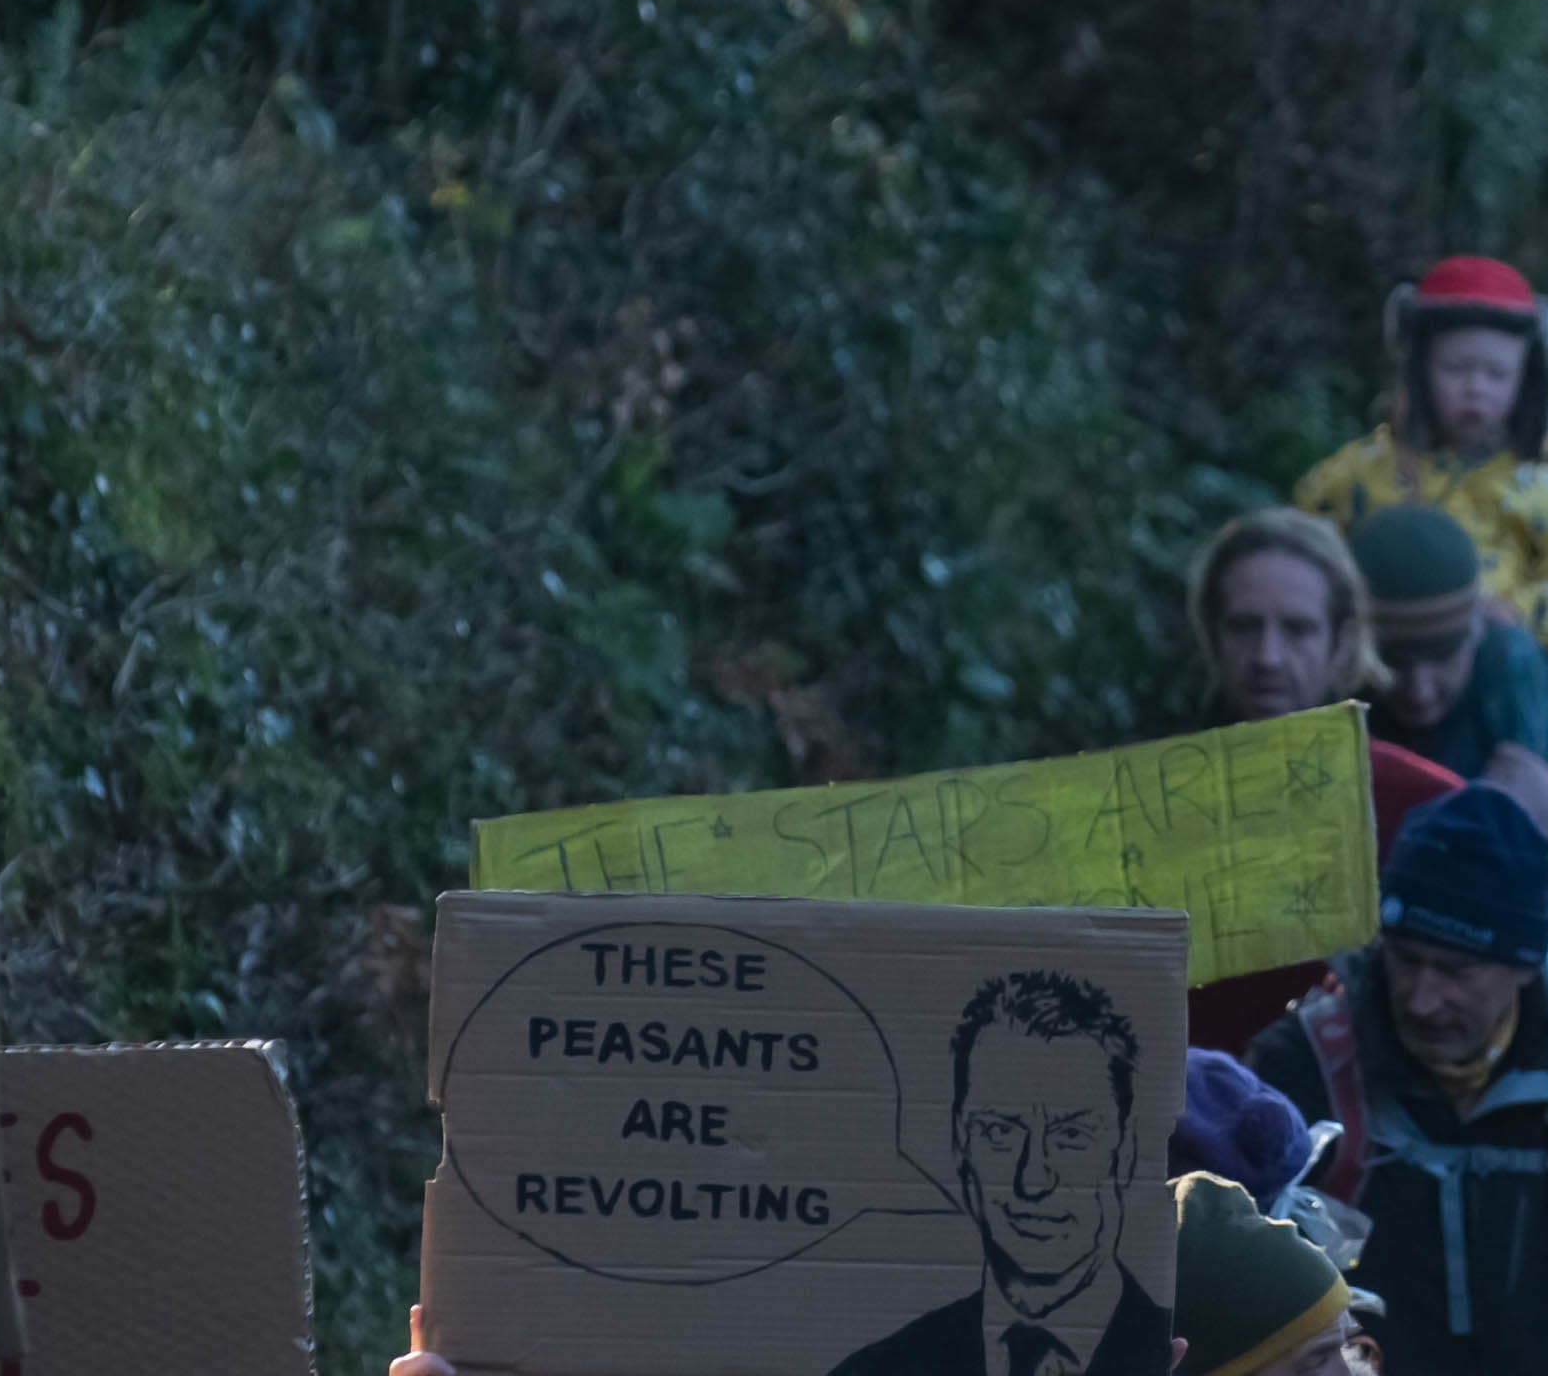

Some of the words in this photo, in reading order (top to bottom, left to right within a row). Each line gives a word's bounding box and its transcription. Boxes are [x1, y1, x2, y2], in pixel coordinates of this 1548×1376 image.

[515, 818, 705, 892] THE
[773, 774, 1052, 895] STARS
[1085, 738, 1275, 850] ARE
[580, 942, 767, 991] THESE
[528, 1016, 820, 1072] PEASANTS
[621, 1098, 730, 1147] ARE
[515, 1173, 830, 1225] REVOLTING
